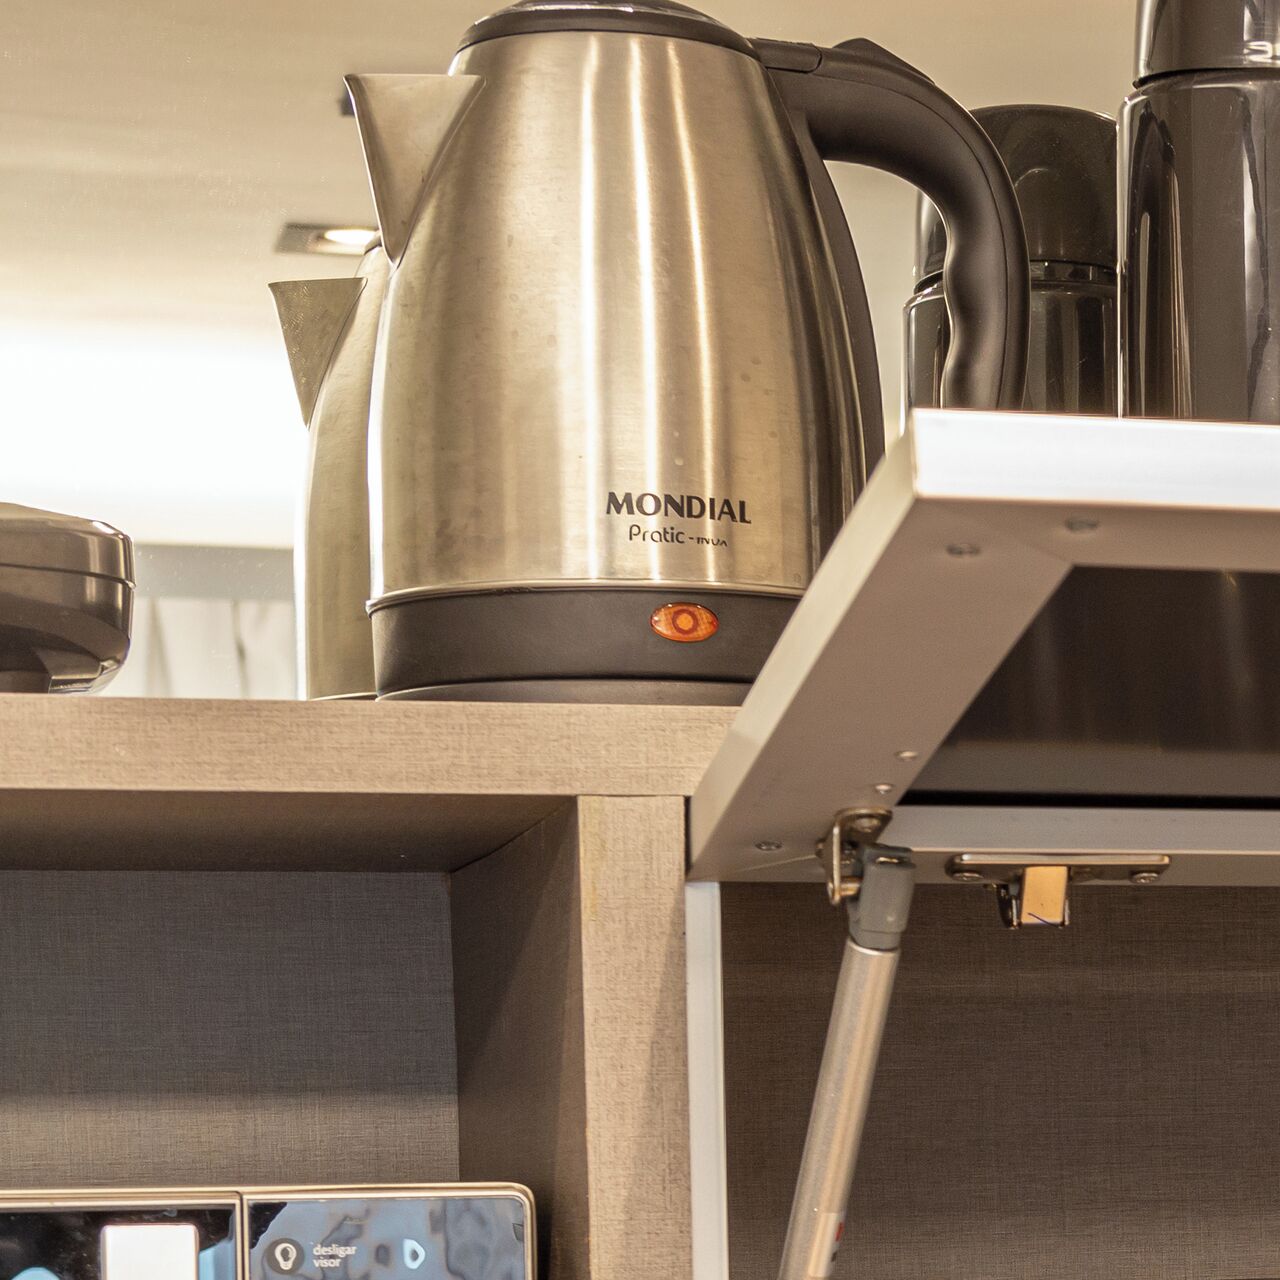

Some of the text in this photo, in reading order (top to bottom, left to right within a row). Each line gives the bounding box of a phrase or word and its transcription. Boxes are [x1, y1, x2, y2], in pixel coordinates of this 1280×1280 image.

[606, 491, 752, 524] MONDIAL
[628, 523, 685, 544] Pratic
[313, 1243, 357, 1256] desligar
[313, 1256, 341, 1268] visor
